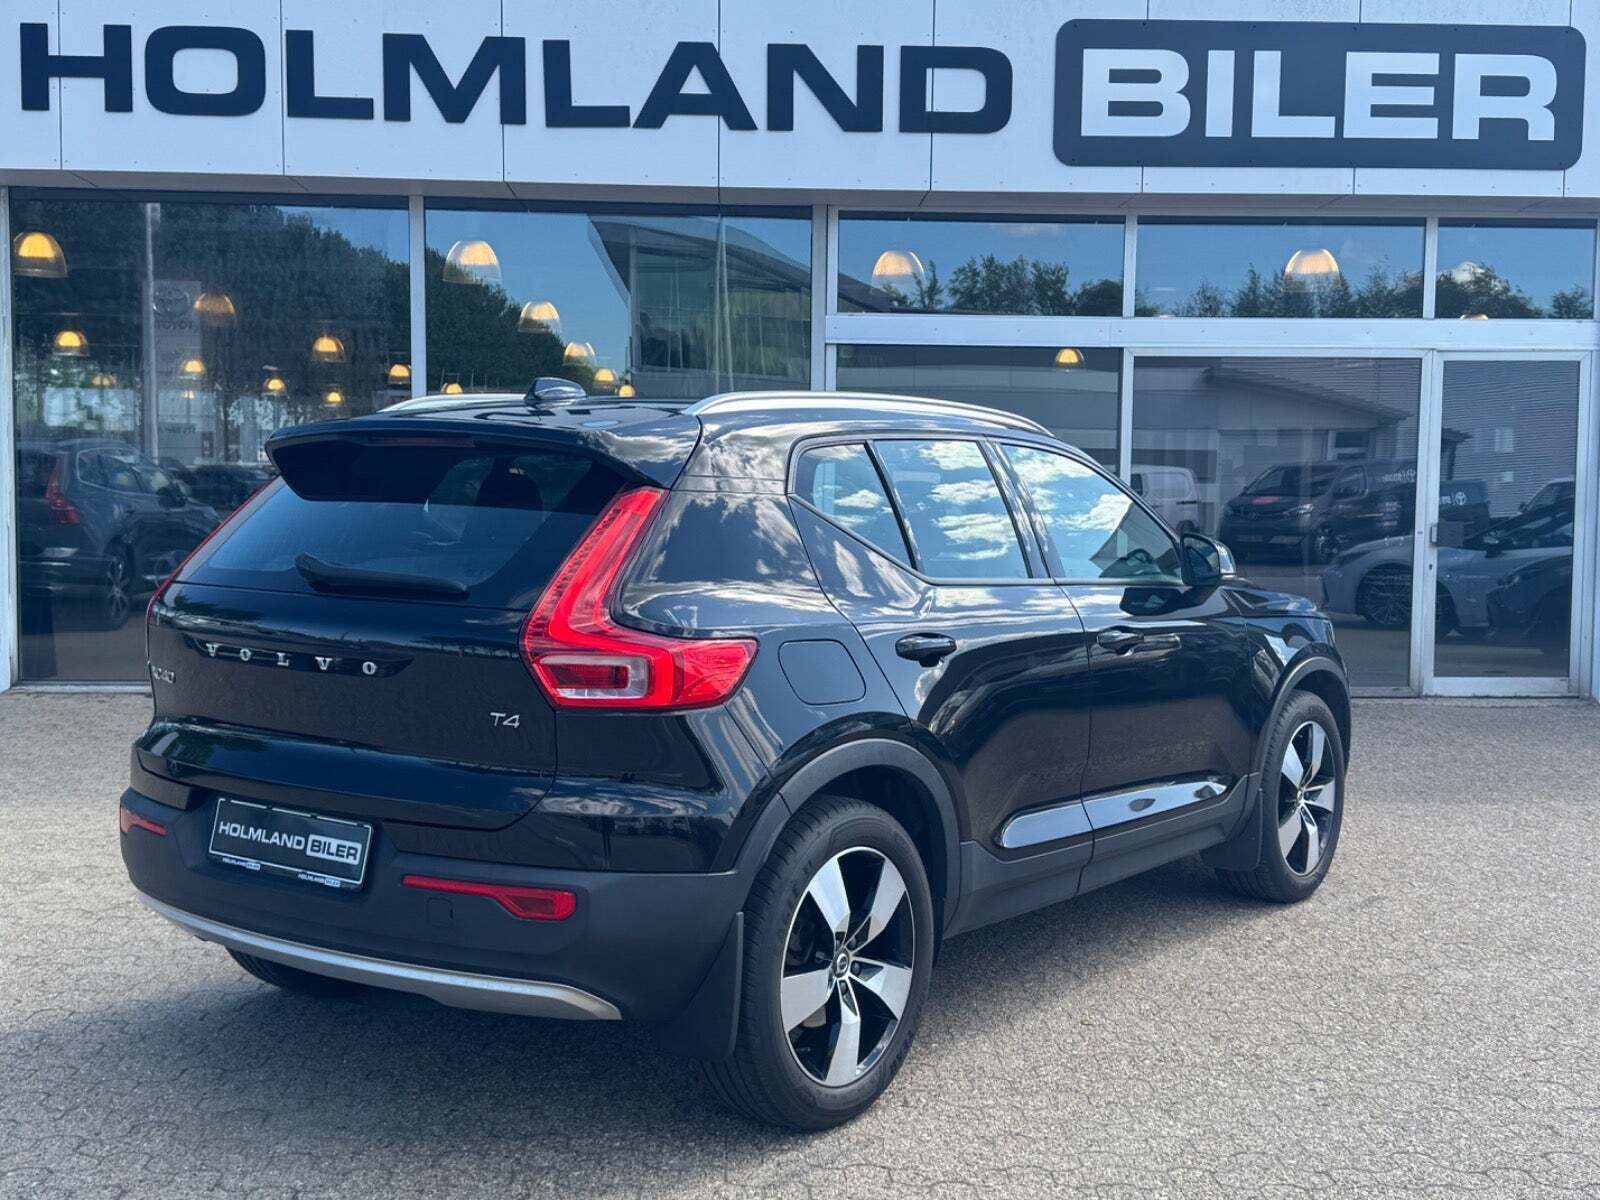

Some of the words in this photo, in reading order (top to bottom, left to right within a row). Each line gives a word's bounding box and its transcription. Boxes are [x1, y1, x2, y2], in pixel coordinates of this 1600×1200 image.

[20, 22, 1013, 135] HOLMLAND
[1080, 48, 1558, 141] BILER
[205, 643, 377, 675] VOLVO
[490, 712, 521, 729] T4
[218, 821, 306, 850] HOLMLAND
[309, 839, 359, 861] BILER
